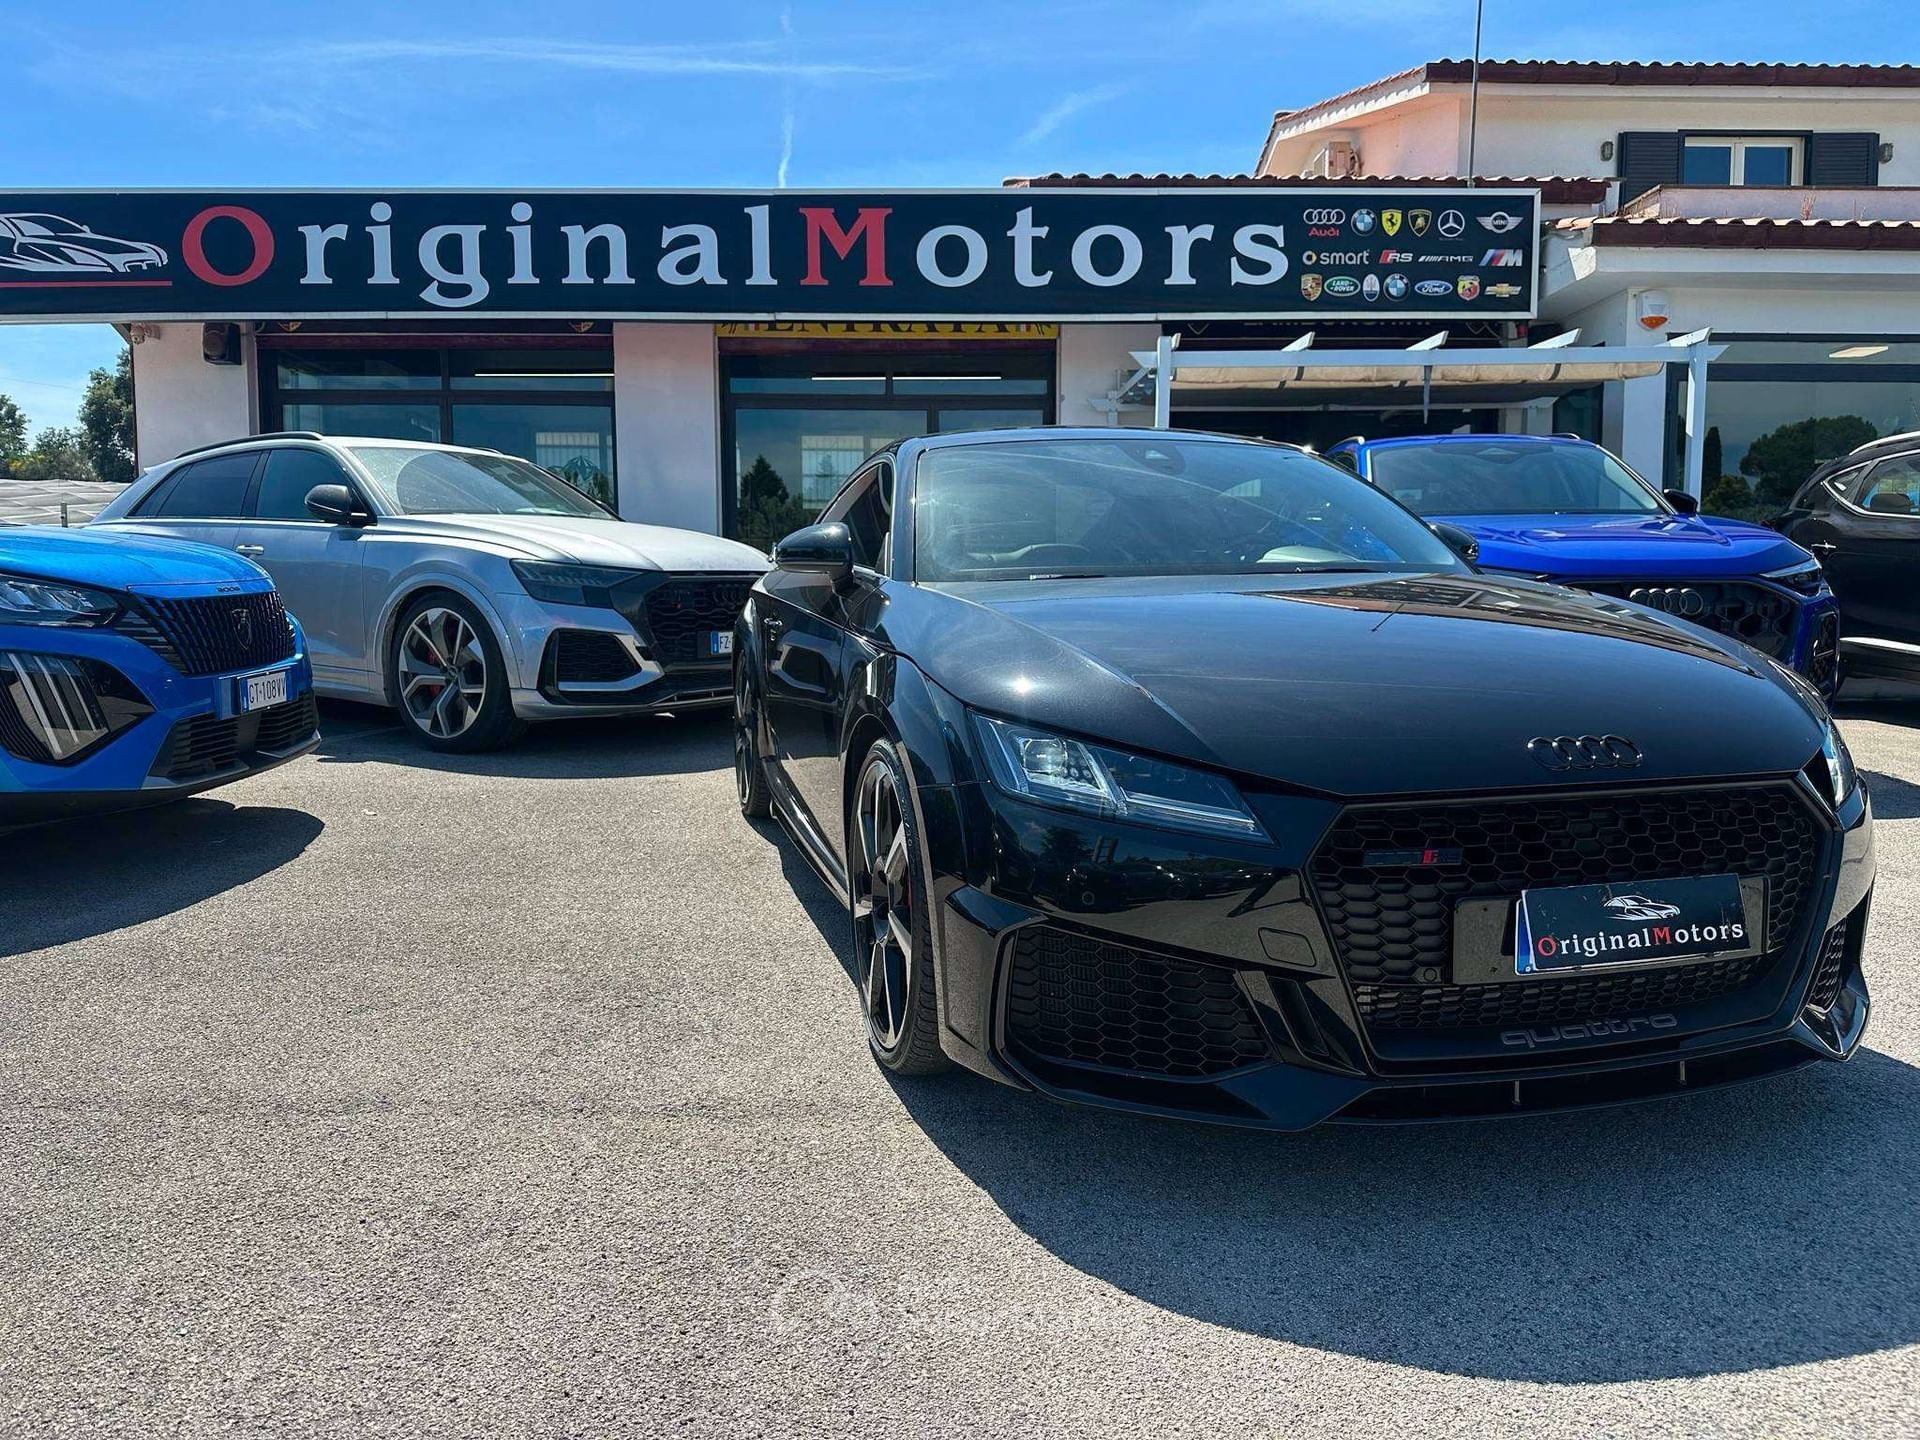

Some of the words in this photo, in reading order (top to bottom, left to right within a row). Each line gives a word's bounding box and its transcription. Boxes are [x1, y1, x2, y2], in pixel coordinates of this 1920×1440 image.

[1308, 226, 1340, 237] Audi
[1319, 251, 1369, 265] smart
[1422, 282, 1446, 293] Ford
[1502, 1013, 1678, 1048] quattro
